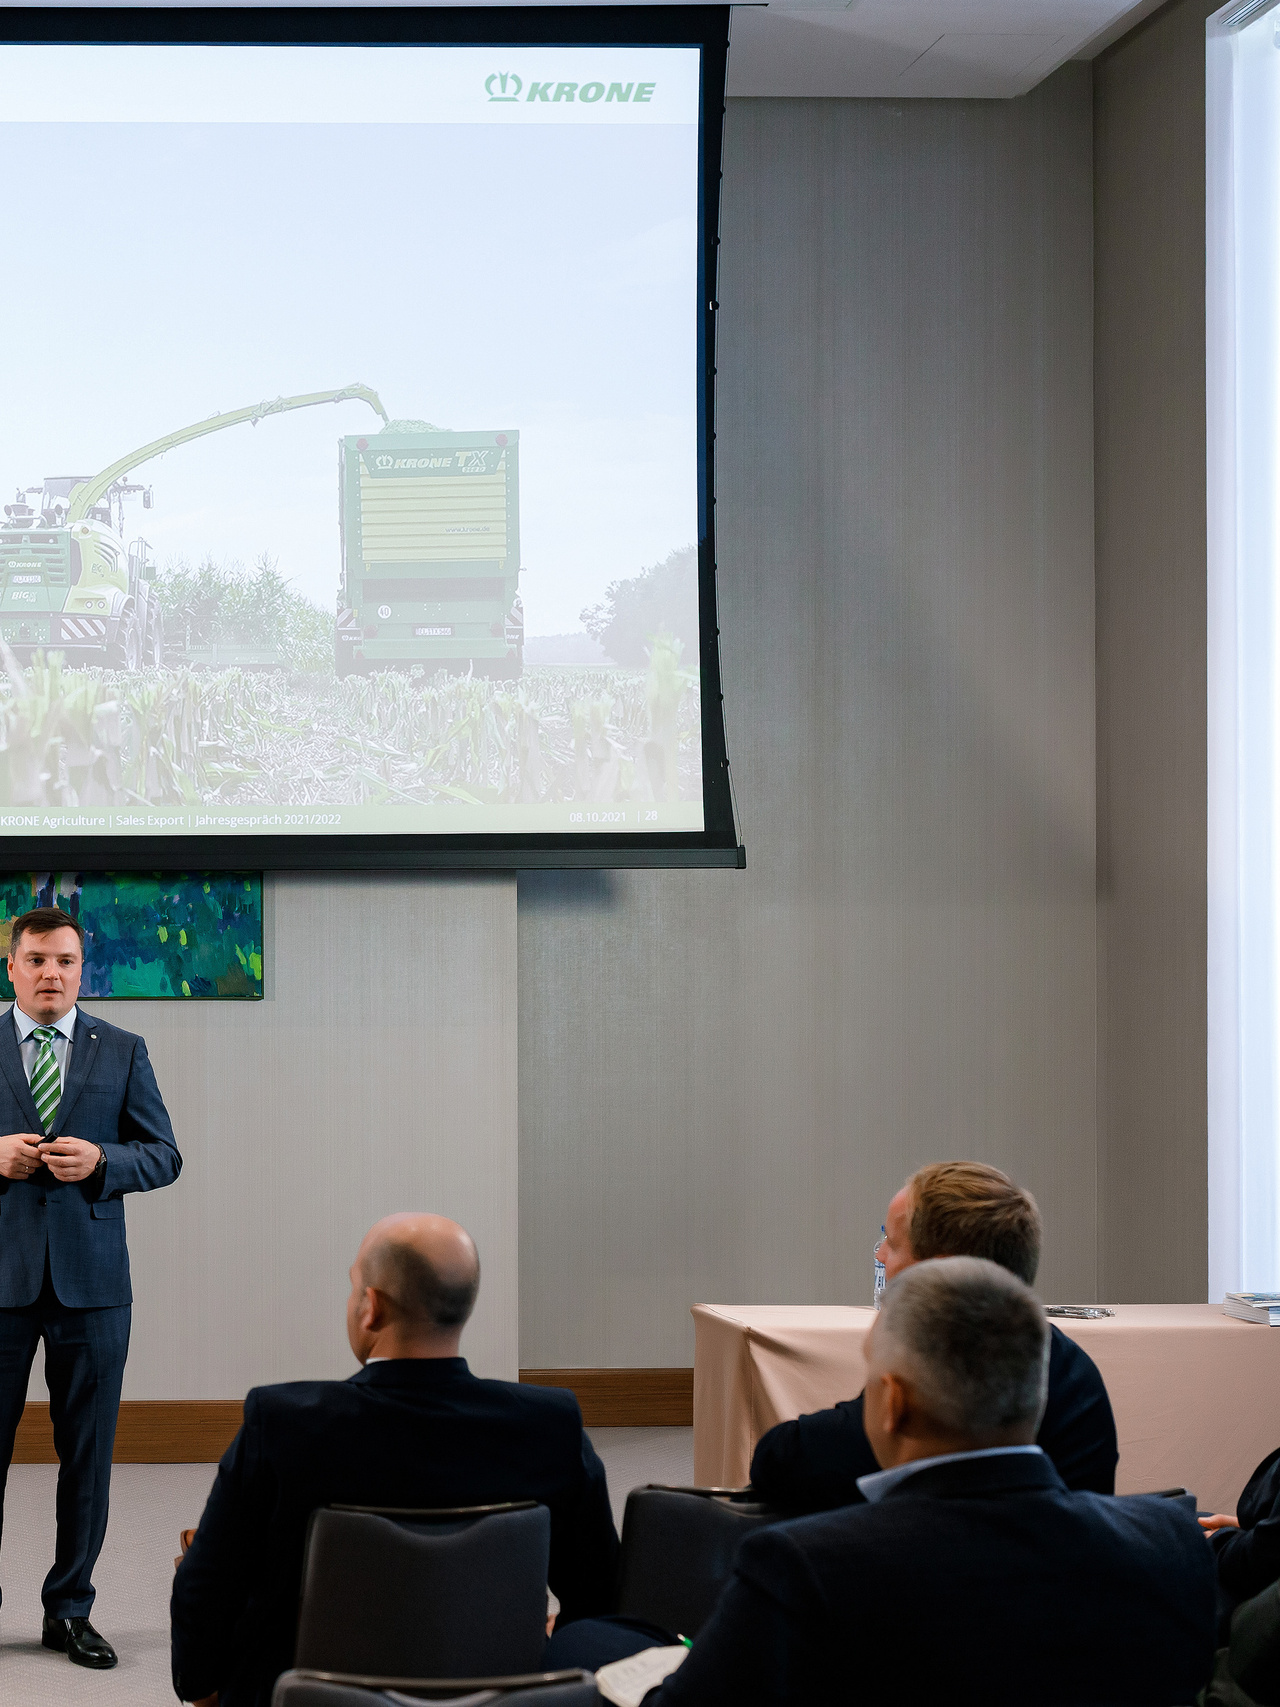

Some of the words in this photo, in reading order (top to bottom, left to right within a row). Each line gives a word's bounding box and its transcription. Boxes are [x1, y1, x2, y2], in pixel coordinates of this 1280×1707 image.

[525, 81, 657, 104] KRONE
[394, 457, 452, 469] KRONE
[455, 451, 489, 466] TX
[379, 606, 390, 617] 40
[0, 815, 40, 826] KRONE
[42, 814, 106, 829] Agriculture
[115, 814, 146, 826] Sales
[147, 815, 184, 828] Export
[194, 814, 282, 828] Jahresgespräch
[284, 813, 341, 825] 2021/2022
[569, 811, 626, 823] 08.10.2021
[644, 810, 658, 821] 28
